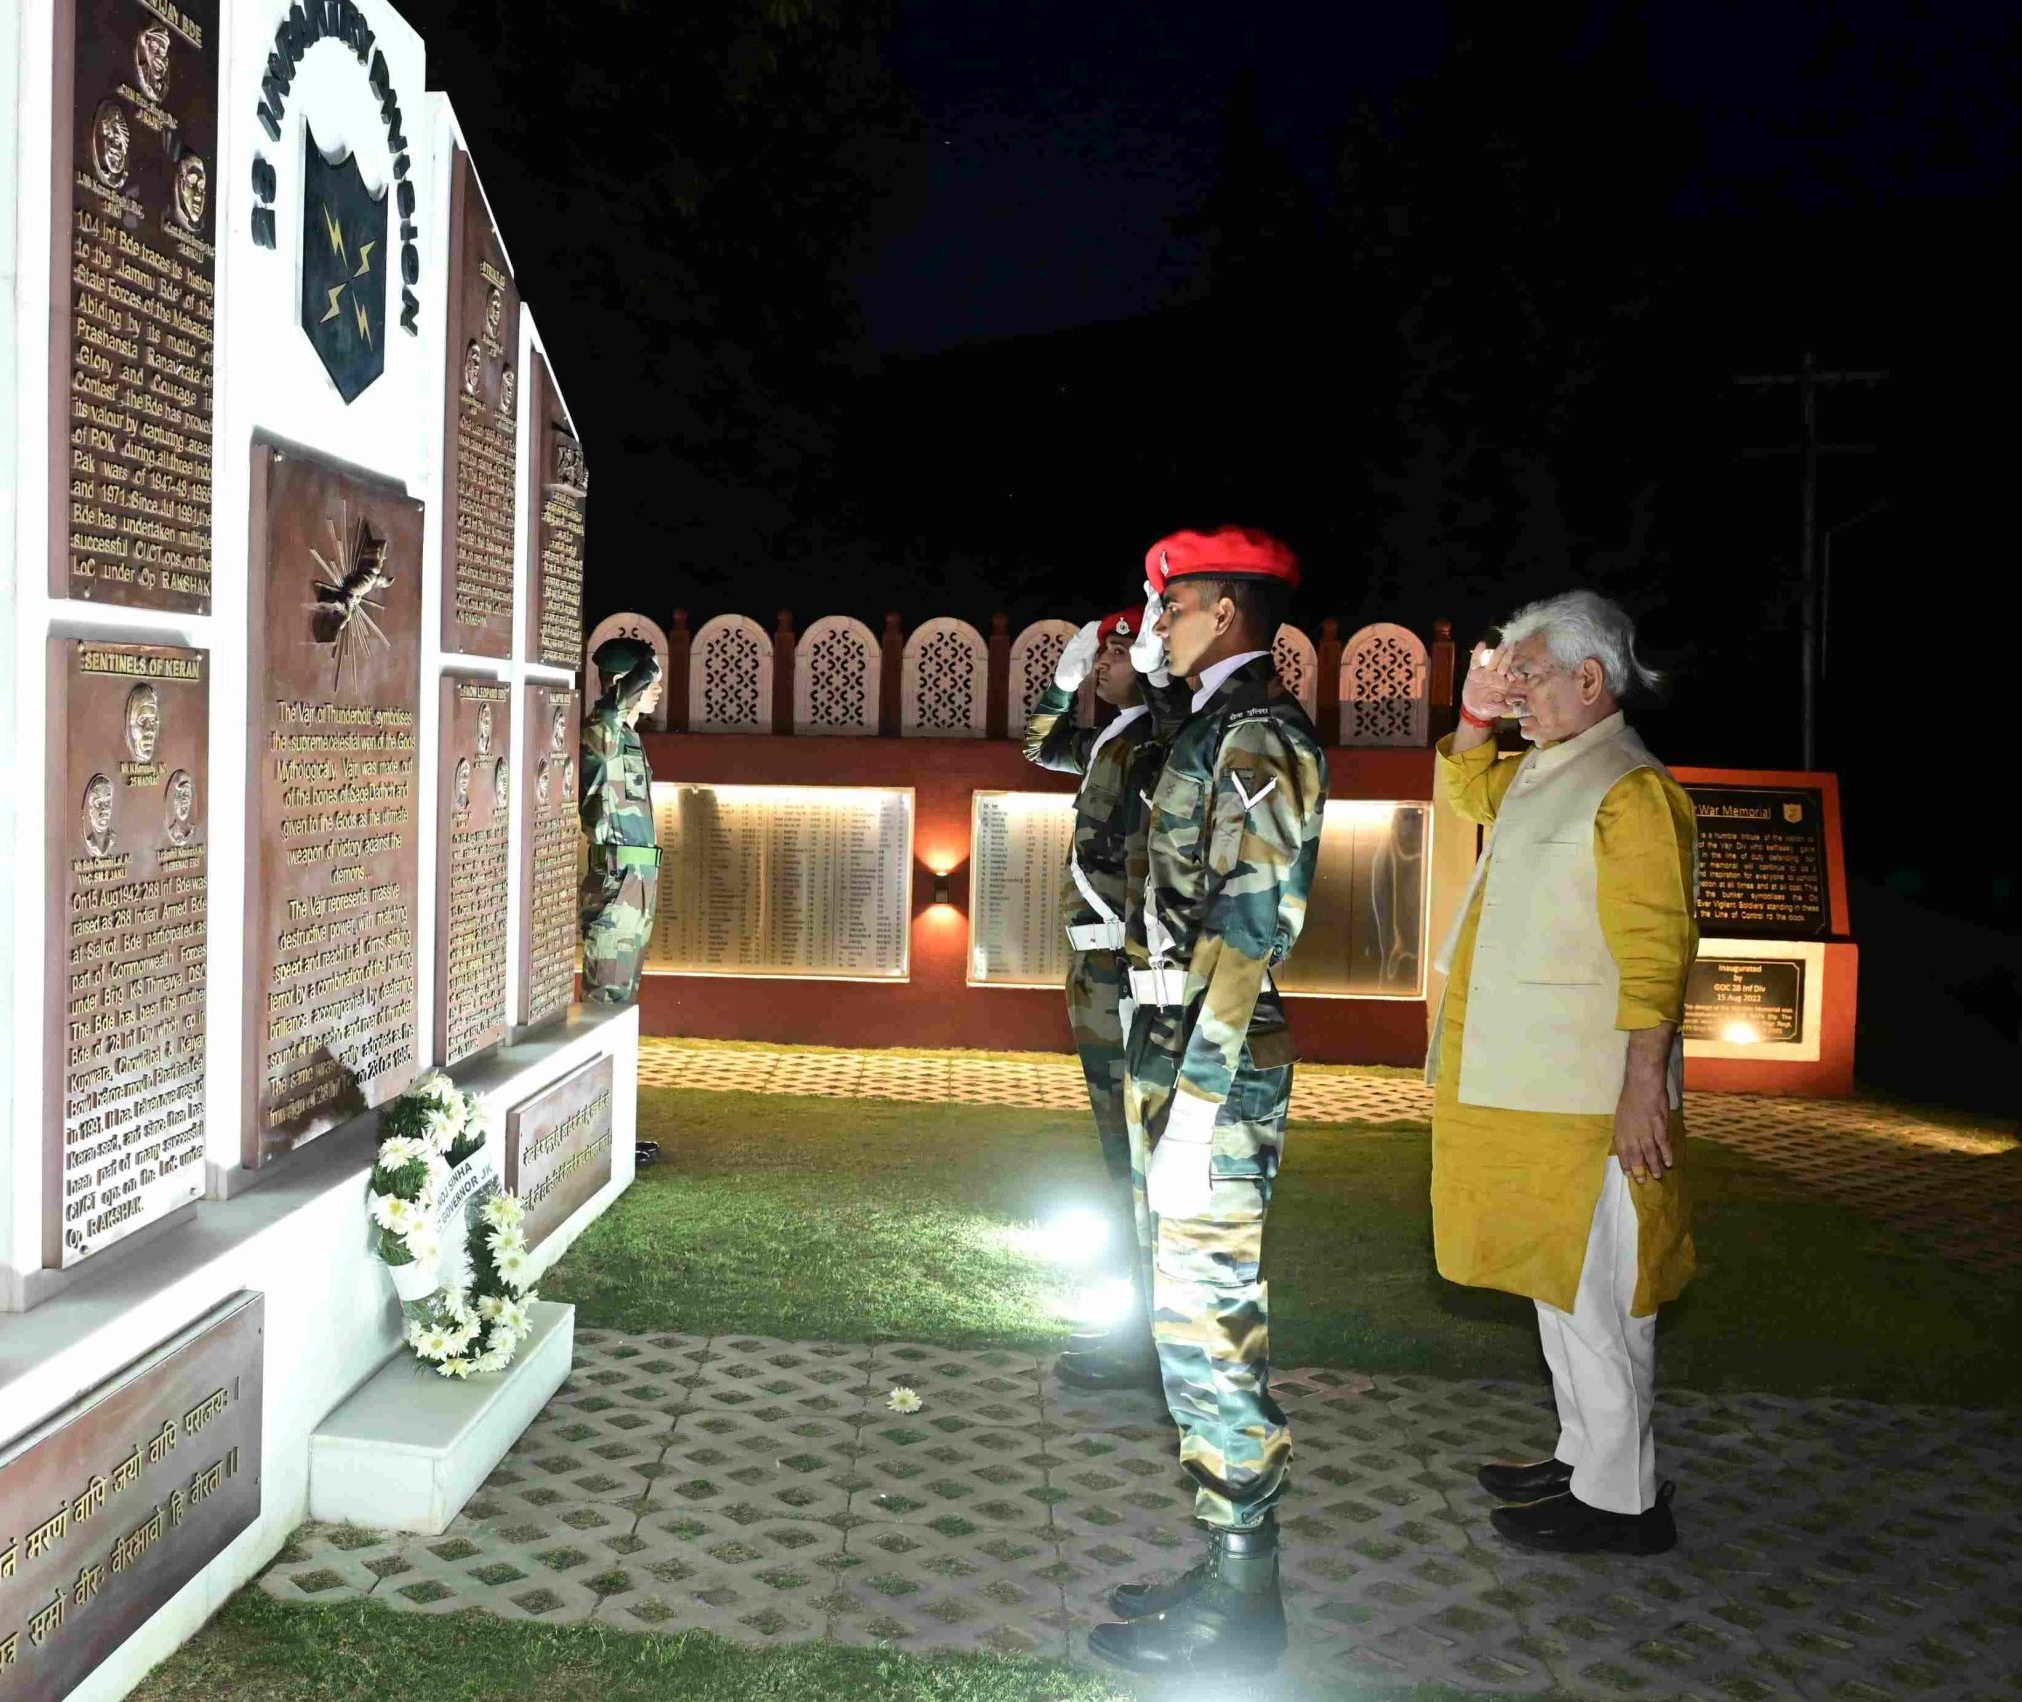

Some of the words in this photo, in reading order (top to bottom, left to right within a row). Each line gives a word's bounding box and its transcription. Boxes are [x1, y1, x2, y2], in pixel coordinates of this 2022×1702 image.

[369, 45, 420, 337] DIVISION
[76, 209, 99, 237] 104
[103, 222, 116, 244] Inf
[119, 231, 140, 256] Bde
[142, 243, 170, 272] traces
[74, 263, 105, 291] State
[108, 278, 141, 309] Forces
[156, 301, 170, 322] the
[76, 238, 89, 258] to
[92, 246, 111, 269] the
[117, 258, 155, 291] Jammu
[184, 293, 195, 309] of
[200, 299, 214, 320] the
[75, 292, 121, 330] Abiding
[127, 312, 141, 337] by
[147, 321, 160, 342] its
[167, 335, 195, 358] motto
[76, 345, 113, 378] Glory
[119, 365, 144, 385] and
[150, 374, 197, 406] Courage
[73, 397, 88, 418] its
[91, 404, 124, 429] valour
[126, 413, 138, 437] by
[142, 423, 184, 452] capturing
[126, 388, 143, 407] the
[144, 394, 162, 417] Bde
[164, 401, 181, 423] has
[91, 428, 115, 453] POK
[121, 442, 155, 467] during
[72, 450, 95, 474] Pak
[103, 462, 128, 480] wars
[133, 468, 146, 485] of
[71, 480, 94, 498] and
[129, 491, 158, 513] Since
[159, 500, 174, 518] Jul
[71, 503, 95, 524] Bde
[96, 507, 117, 529] has
[123, 516, 175, 542] undertaken
[71, 533, 128, 557] successful
[72, 555, 96, 577] LoC
[104, 563, 136, 583] under
[138, 567, 155, 590] Op
[161, 570, 212, 596] RAKSHAK
[82, 652, 147, 676] SENTINELS
[149, 660, 163, 675] OF
[165, 660, 199, 679] KERAN
[279, 701, 296, 723] The
[1699, 804, 1719, 816] War
[1722, 805, 1771, 818] Memorial
[100, 889, 118, 907] Aug
[143, 883, 158, 899] 268
[176, 878, 190, 894] Bde
[72, 916, 99, 938] raised
[115, 911, 132, 928] 268
[135, 904, 158, 924] Indian
[162, 900, 187, 920] Armed
[191, 896, 207, 913] Bde
[124, 932, 141, 951] Bde
[146, 925, 195, 948] participated
[110, 950, 173, 981] Commonwealth
[72, 995, 99, 1017] under
[104, 985, 123, 1009] Brig
[72, 1021, 90, 1042] The
[95, 1013, 113, 1034] Bde
[119, 1009, 136, 1026] has
[71, 1047, 90, 1067] Bde
[448, 1162, 473, 1192] SINHA
[441, 1175, 479, 1223] GOVERNOR
[25, 1500, 70, 1561] मरणं
[72, 1474, 108, 1525] वापि
[112, 1444, 143, 1494] जयो
[150, 1419, 178, 1466] वापि
[28, 1587, 67, 1647] समो
[170, 1491, 188, 1528] हि
[191, 1459, 224, 1506] वीरता
